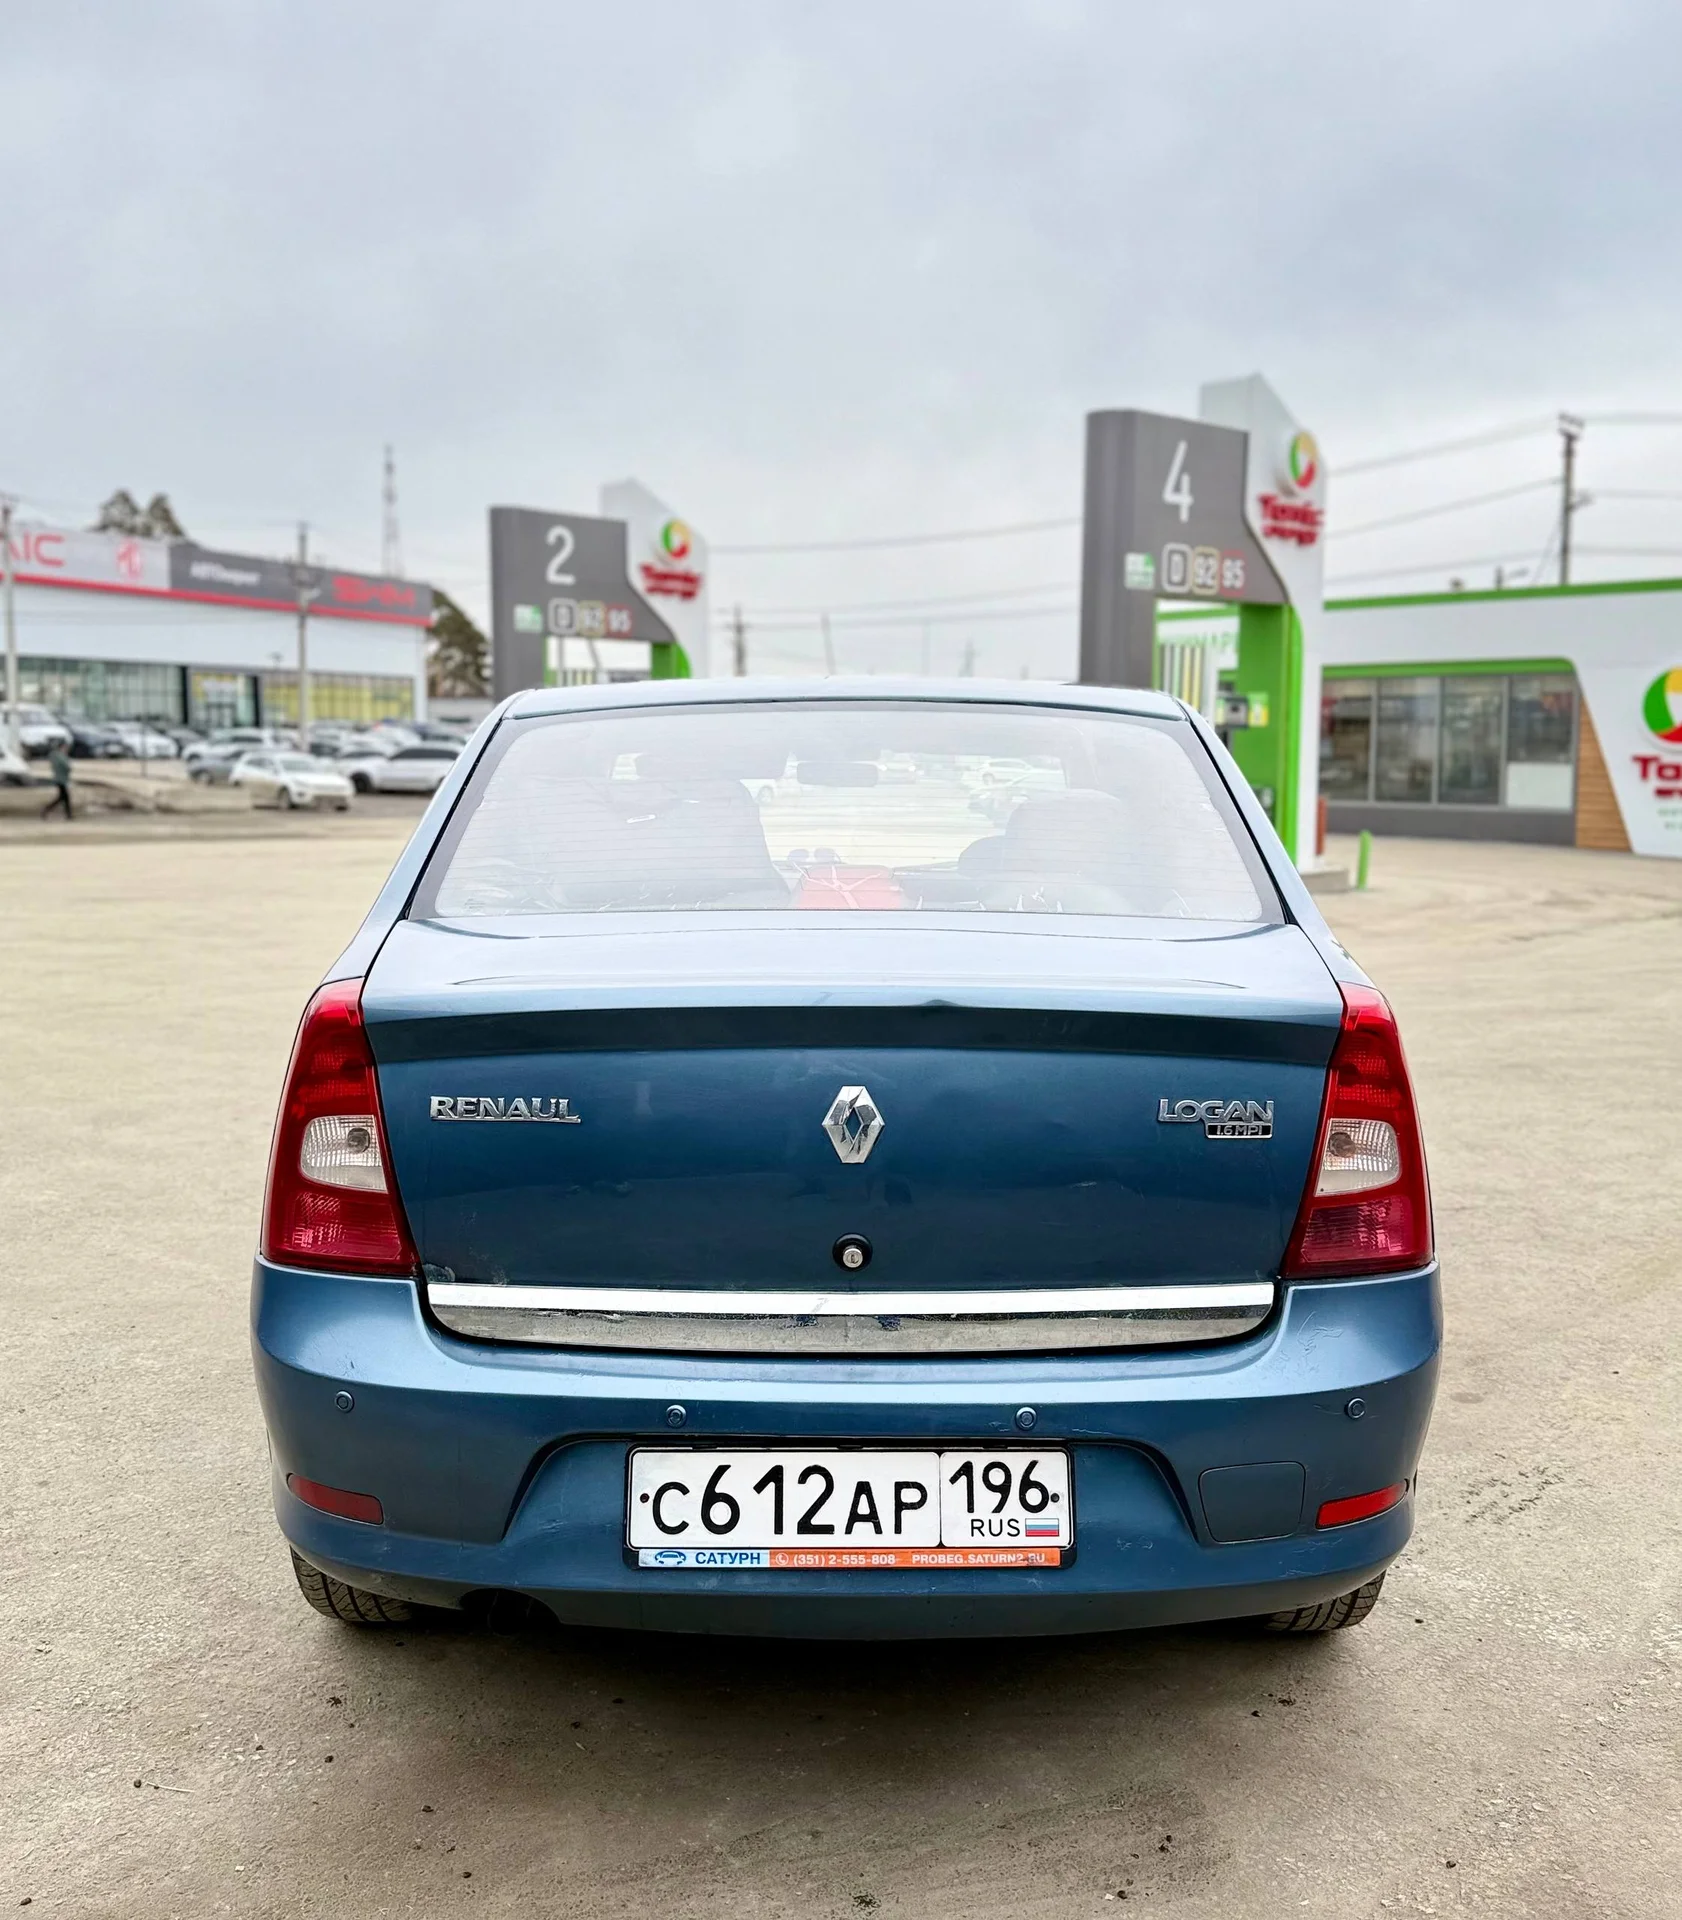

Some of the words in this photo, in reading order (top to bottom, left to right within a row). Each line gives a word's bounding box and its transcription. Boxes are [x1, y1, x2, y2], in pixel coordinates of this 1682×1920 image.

[1162, 439, 1194, 523] 4
[545, 525, 576, 586] 2
[430, 1095, 581, 1123] RENAUL
[1158, 1098, 1275, 1123] LOGAN
[1235, 1125, 1263, 1136] MPI
[948, 1460, 1051, 1514] 196
[970, 1518, 1021, 1538] RUS
[695, 1551, 761, 1566] САТУРН
[793, 1552, 825, 1566] (351)
[828, 1553, 896, 1566] 2-555-808
